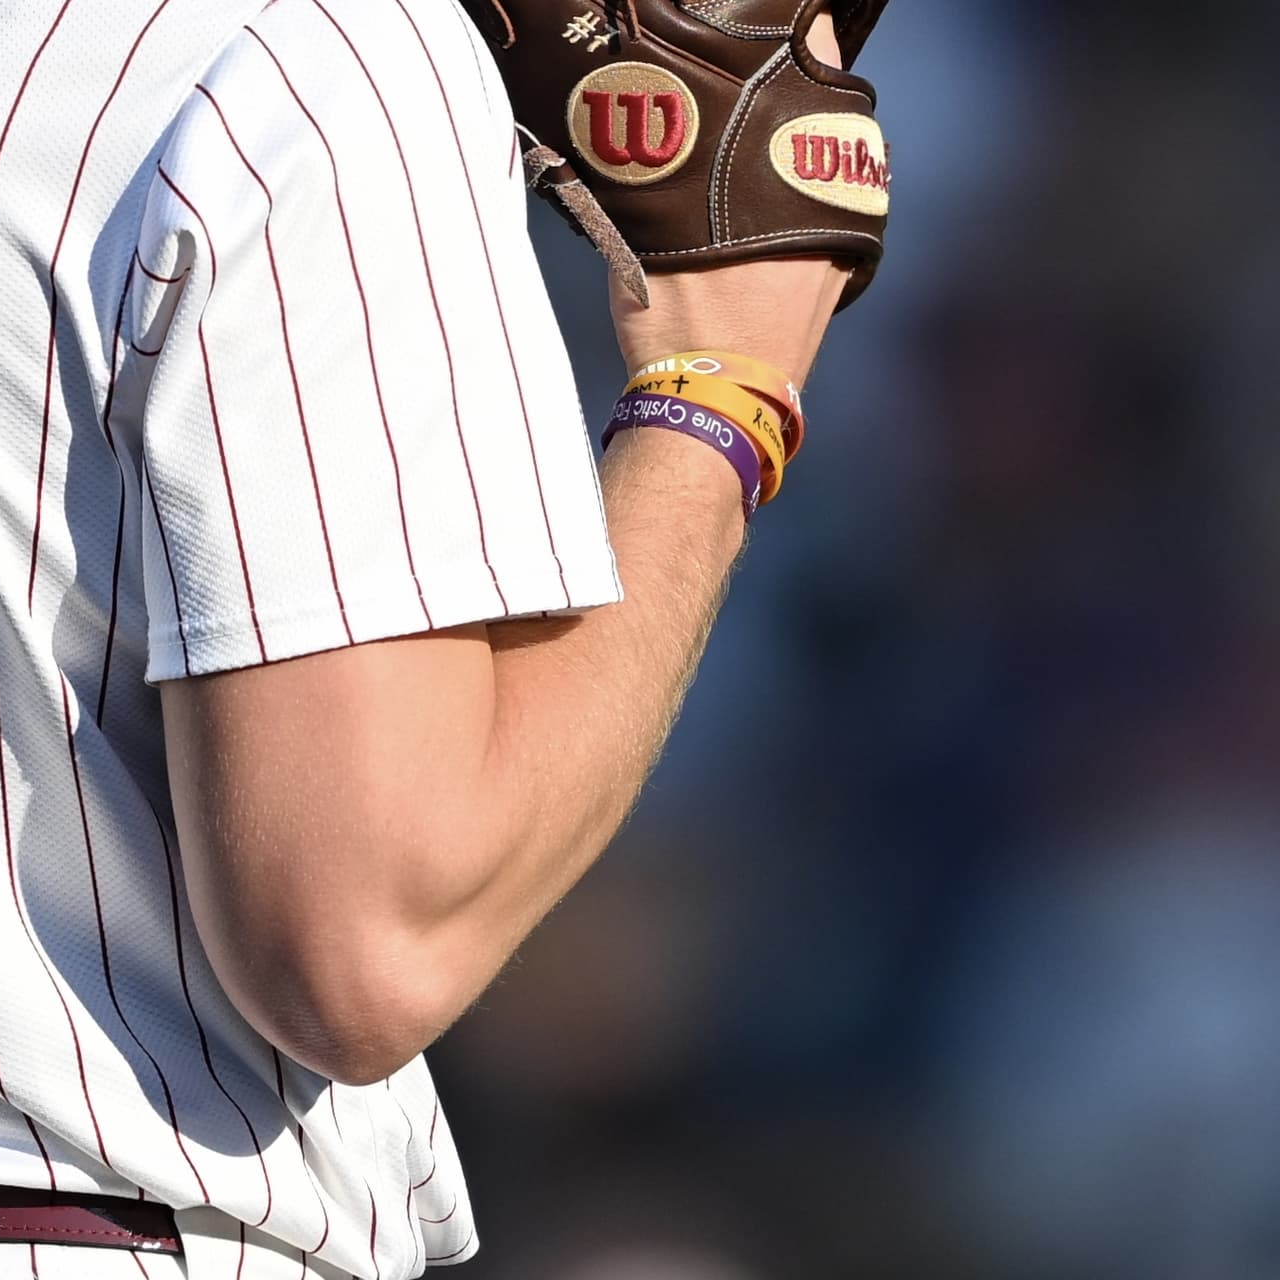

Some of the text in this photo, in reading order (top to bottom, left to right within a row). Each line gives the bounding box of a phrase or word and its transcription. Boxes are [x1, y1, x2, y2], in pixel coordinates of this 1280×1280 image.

[582, 90, 688, 169] W
[633, 398, 686, 424] Cystic
[691, 412, 733, 448] Cure
